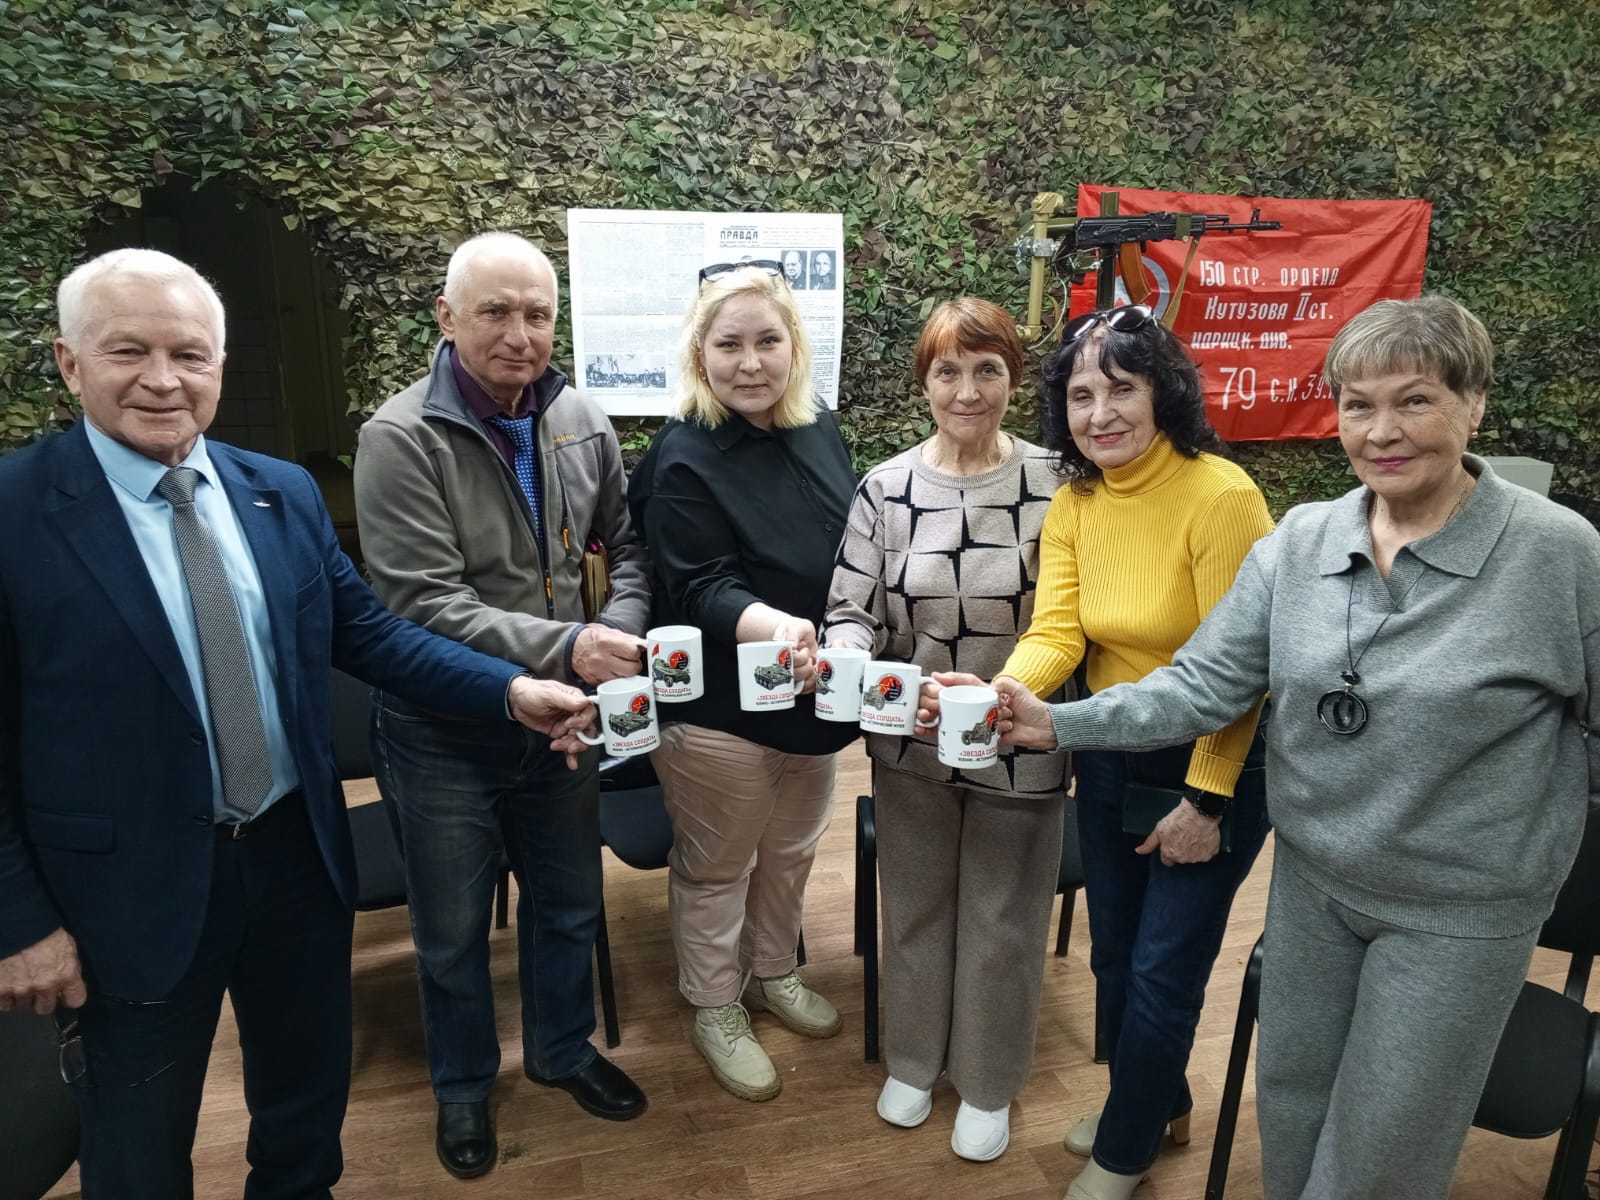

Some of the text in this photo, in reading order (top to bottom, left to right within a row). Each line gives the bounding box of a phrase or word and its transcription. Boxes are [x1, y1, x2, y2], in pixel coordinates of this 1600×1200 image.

[720, 230, 759, 240] ПРАВДА
[1200, 261, 1226, 287] 150
[1220, 368, 1257, 411] 79
